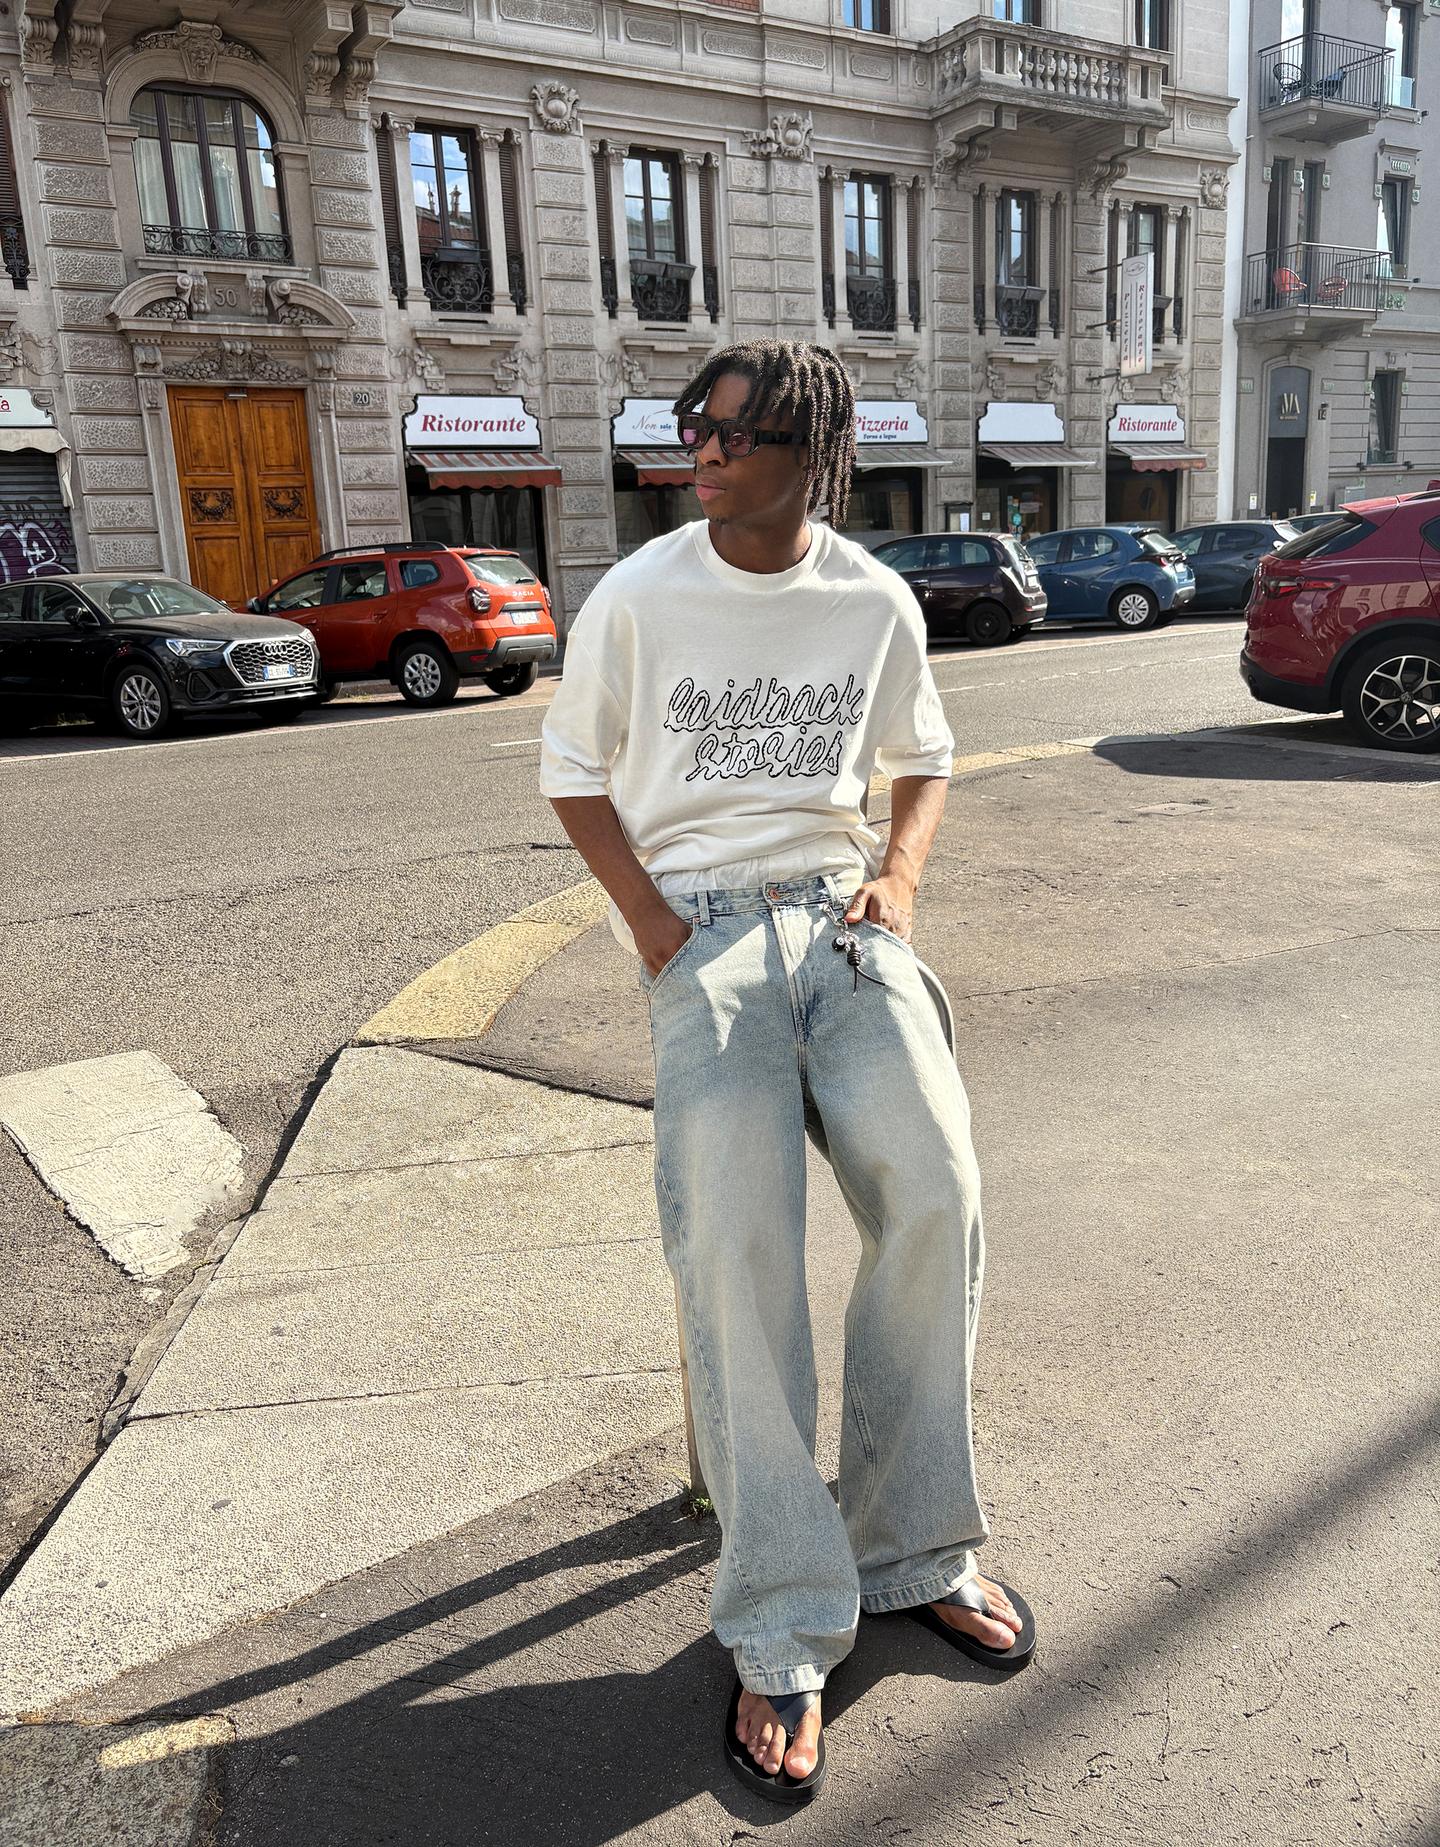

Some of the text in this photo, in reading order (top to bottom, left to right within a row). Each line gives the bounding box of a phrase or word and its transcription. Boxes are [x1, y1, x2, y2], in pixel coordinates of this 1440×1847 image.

[215, 288, 237, 307] 50
[356, 393, 369, 404] 20
[421, 414, 526, 432] Ristorante
[632, 415, 657, 430] Non
[1118, 417, 1178, 432] Ristorante
[664, 674, 864, 733] laidback
